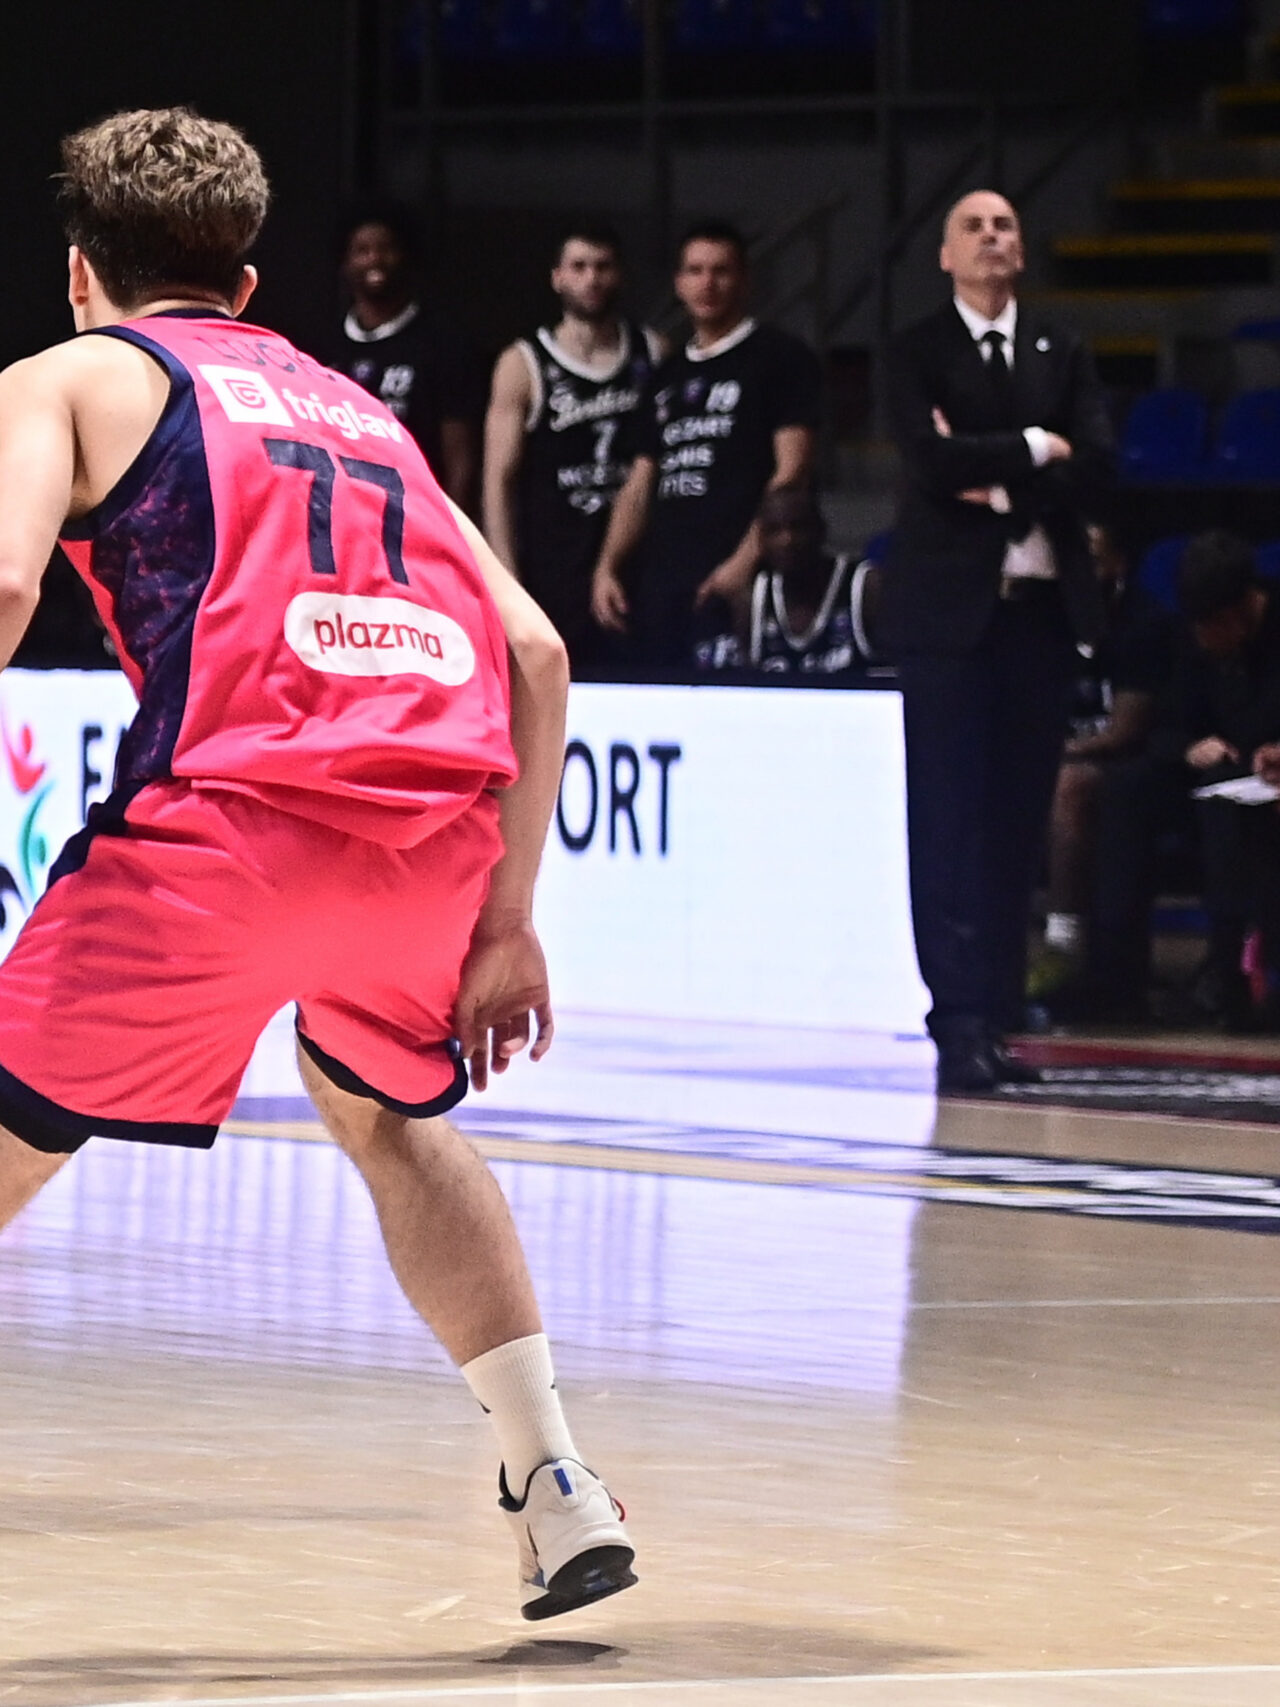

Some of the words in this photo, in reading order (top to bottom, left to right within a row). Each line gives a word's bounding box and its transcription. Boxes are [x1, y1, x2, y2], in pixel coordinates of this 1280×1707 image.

[282, 388, 403, 443] triglav
[262, 438, 409, 585] 77
[314, 613, 443, 660] plazma
[556, 741, 682, 855] ORT
